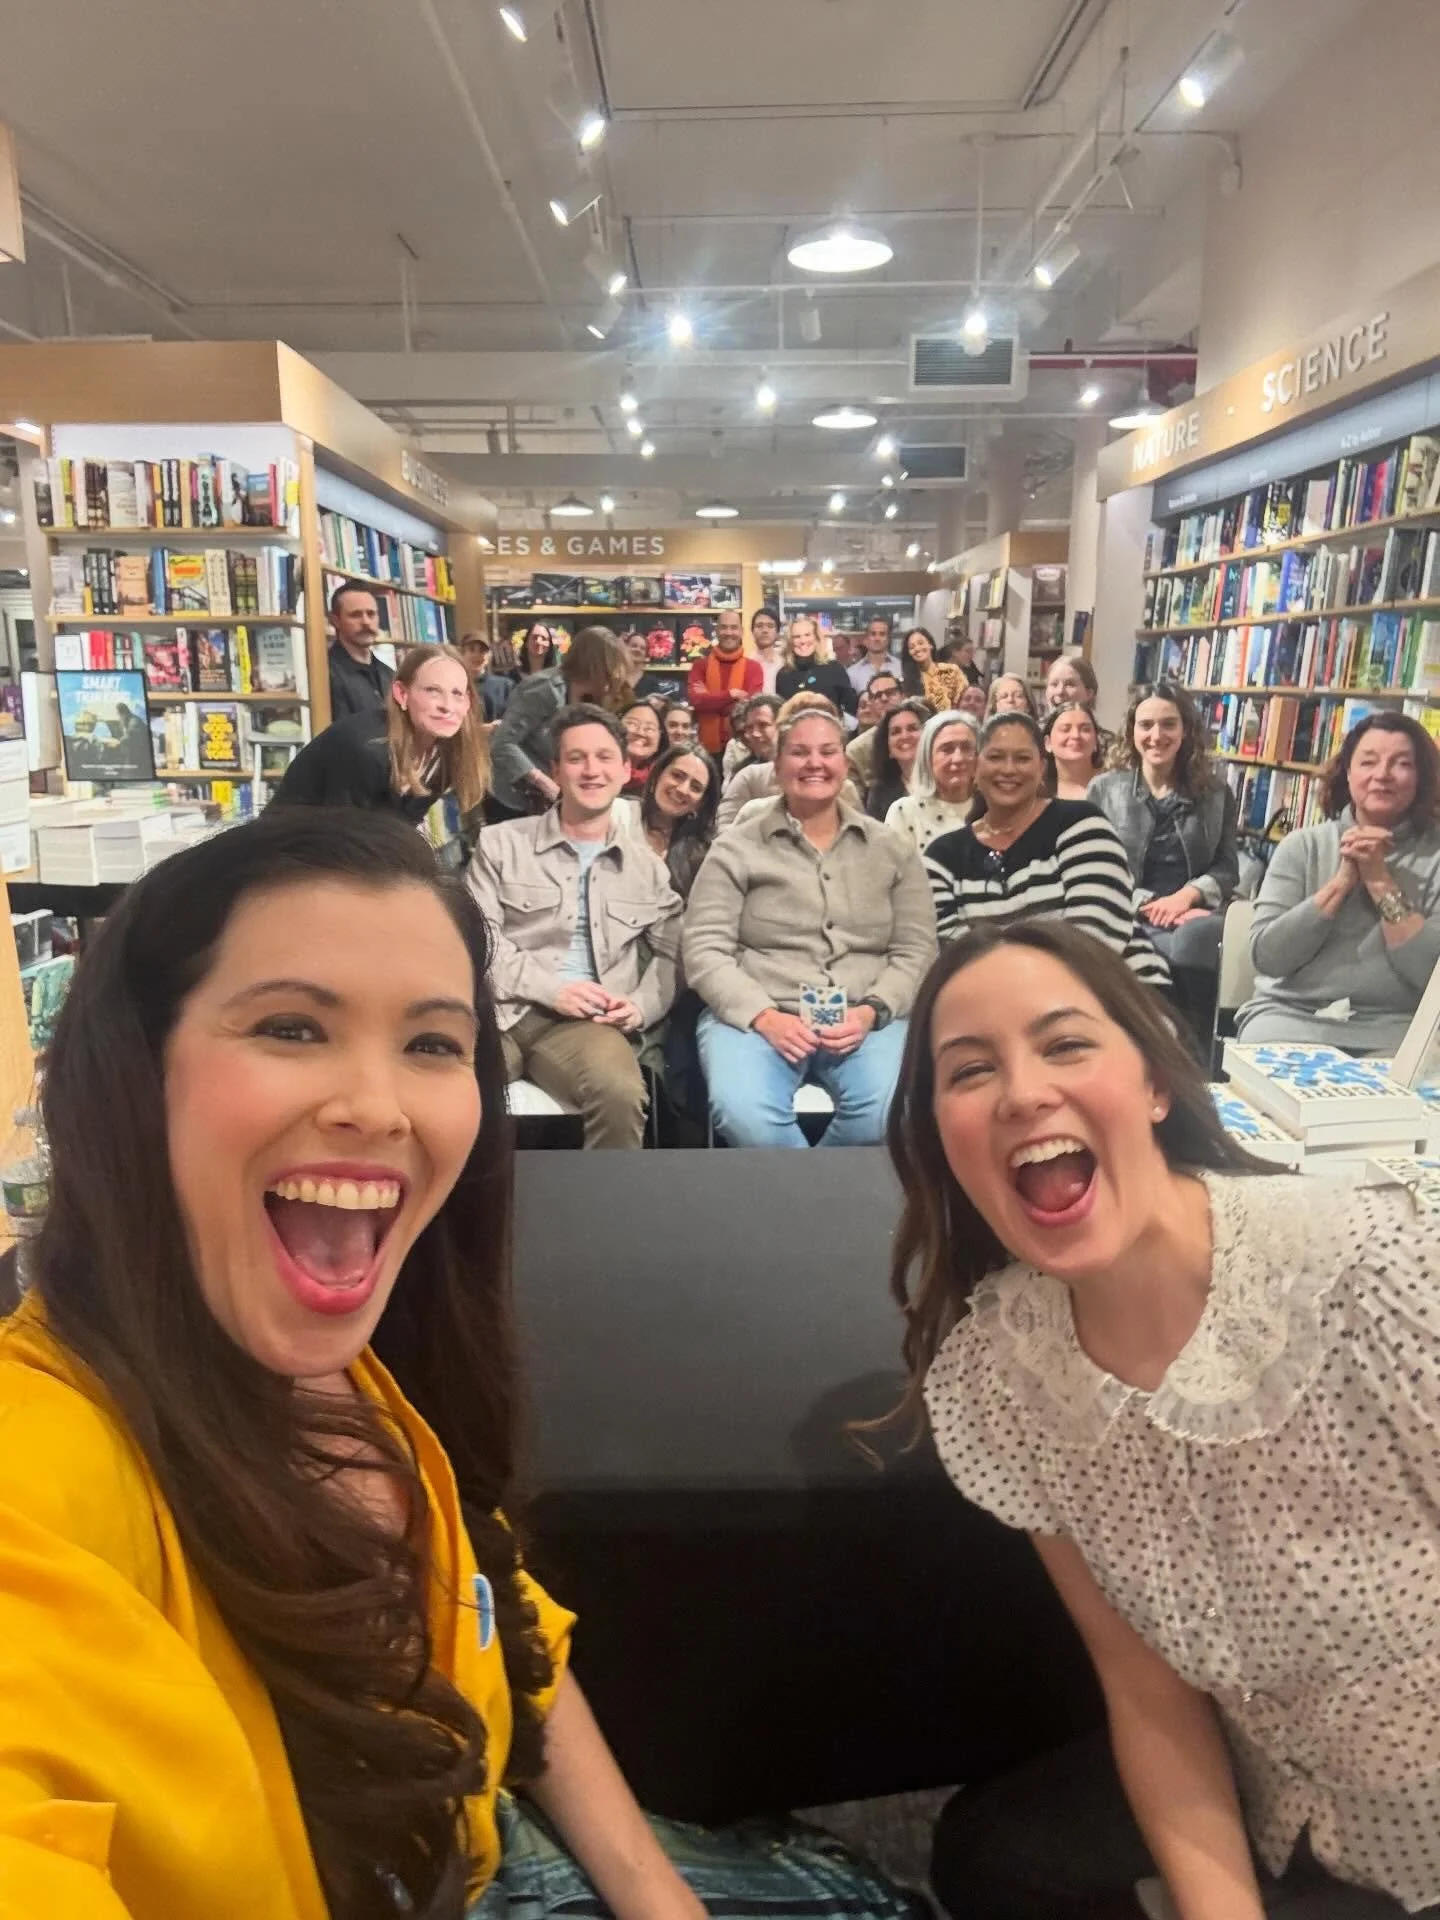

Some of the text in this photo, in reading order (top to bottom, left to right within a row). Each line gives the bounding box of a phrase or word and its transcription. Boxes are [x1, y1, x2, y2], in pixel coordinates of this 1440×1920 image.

[1132, 311, 1389, 473] NATURE SCIENCE
[539, 535, 557, 556] &
[567, 536, 665, 556] GAMES
[810, 577, 845, 593] A-Z
